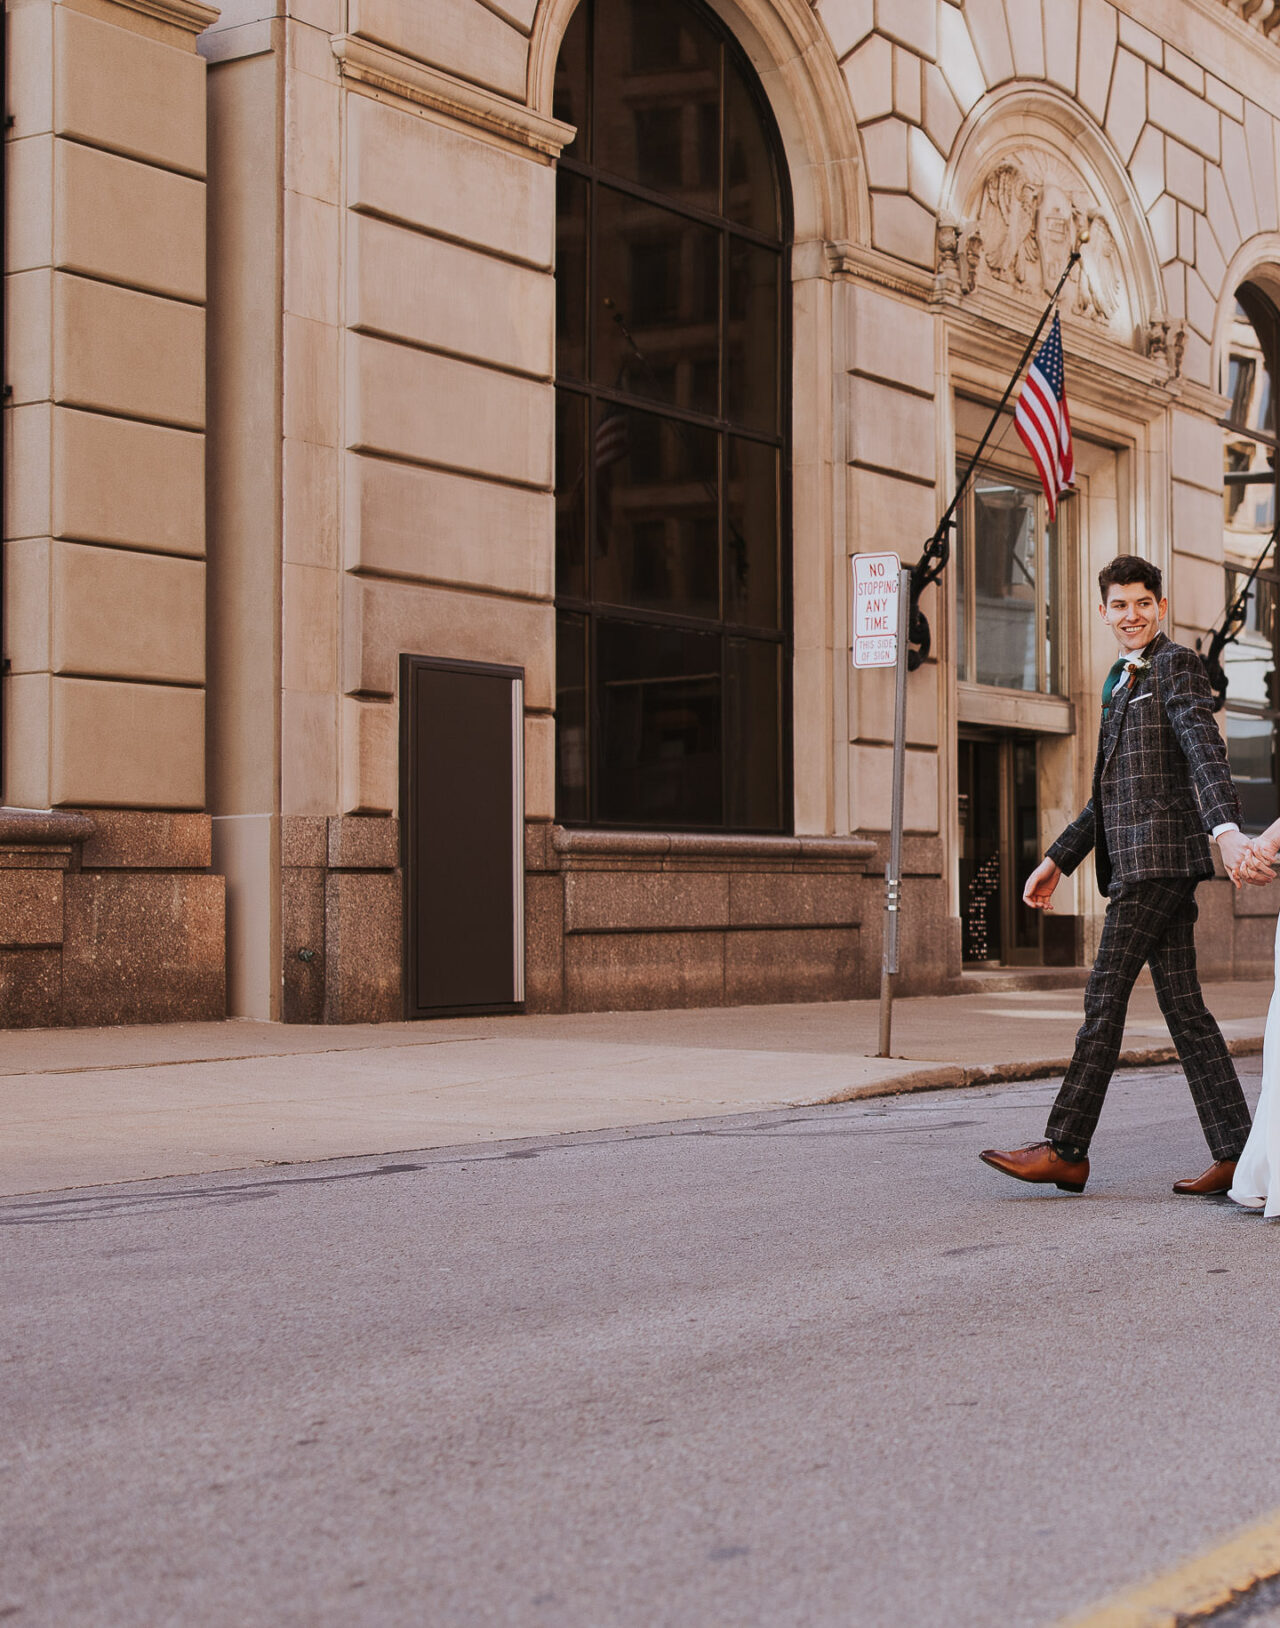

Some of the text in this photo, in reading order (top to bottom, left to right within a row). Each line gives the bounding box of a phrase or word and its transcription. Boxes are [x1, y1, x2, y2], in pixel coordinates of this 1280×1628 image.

[869, 563, 885, 577] NO
[858, 580, 897, 596] STOPPING
[866, 598, 888, 613] ANY
[864, 615, 888, 631] TIME
[859, 639, 892, 650] THIS SIDE
[861, 650, 890, 661] OF SIGN
